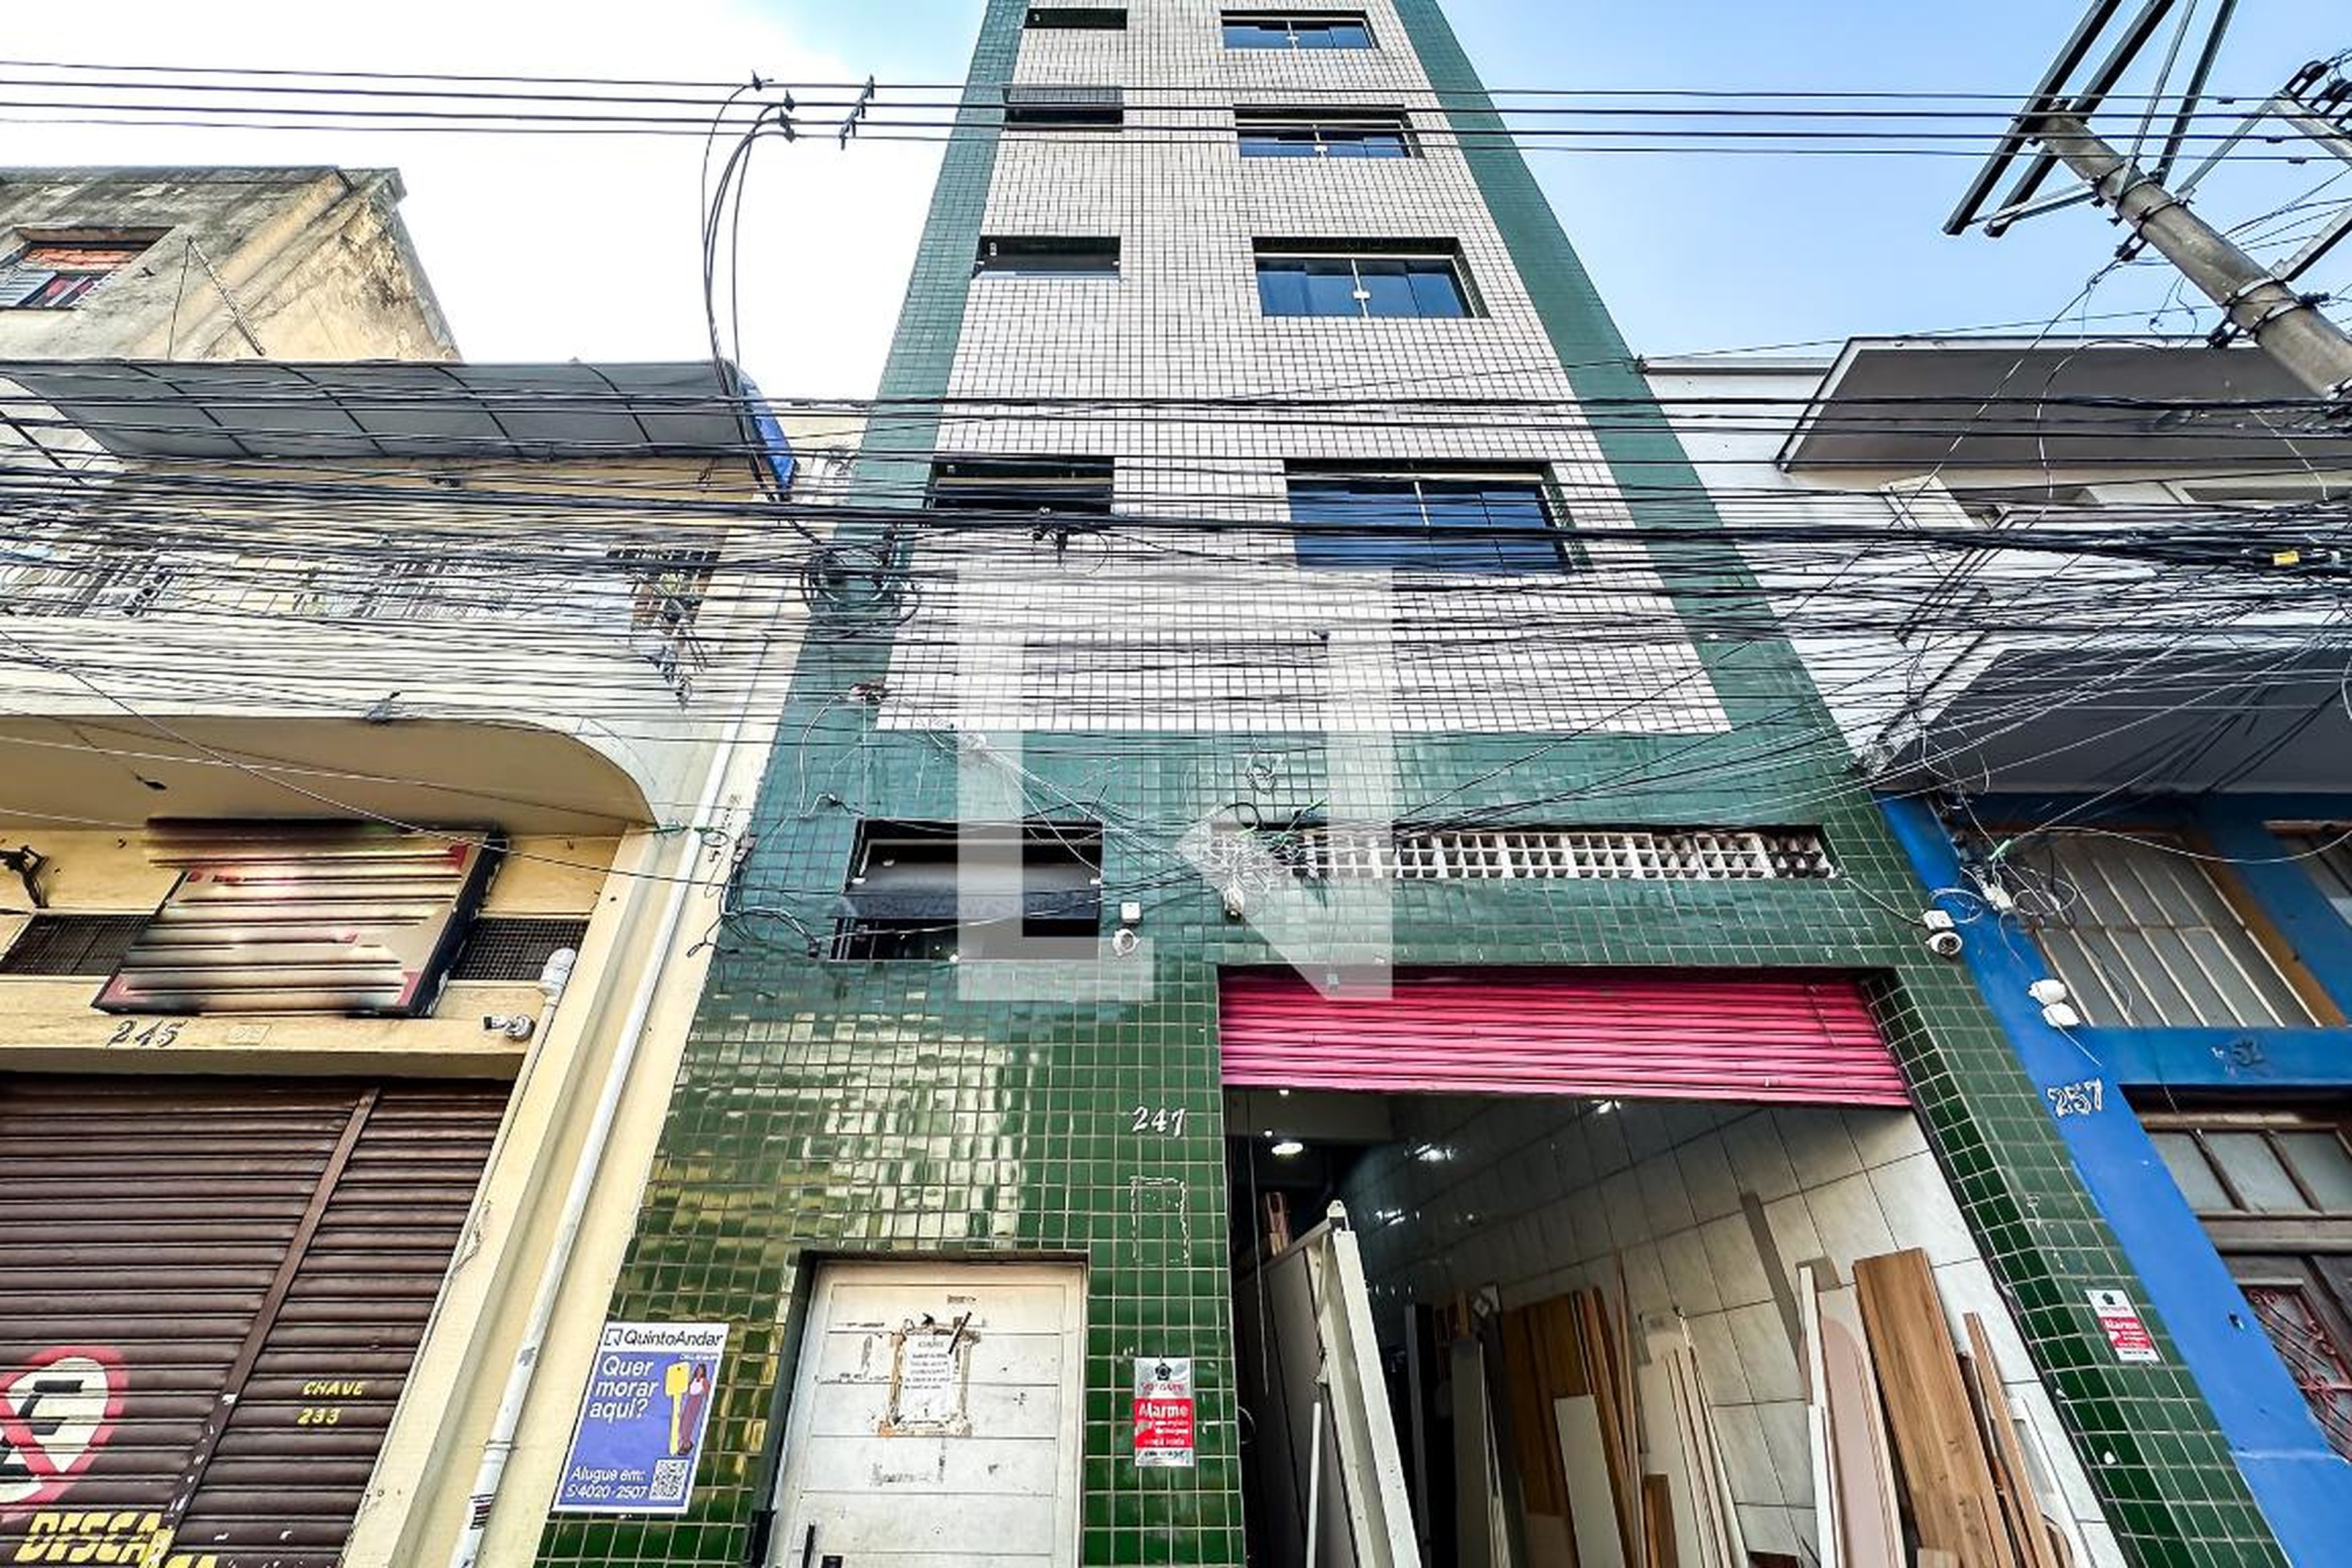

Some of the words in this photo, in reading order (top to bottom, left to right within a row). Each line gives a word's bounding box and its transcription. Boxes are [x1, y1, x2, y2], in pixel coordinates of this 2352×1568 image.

[106, 1019, 188, 1047] 245
[2047, 1078, 2101, 1117] 257
[1132, 1106, 1186, 1137] 247
[624, 1329, 723, 1347] QuintoAndar
[603, 1355, 654, 1376] Quer
[596, 1381, 658, 1398] morar
[589, 1398, 648, 1424] aqui?
[571, 1466, 619, 1484] Alugue
